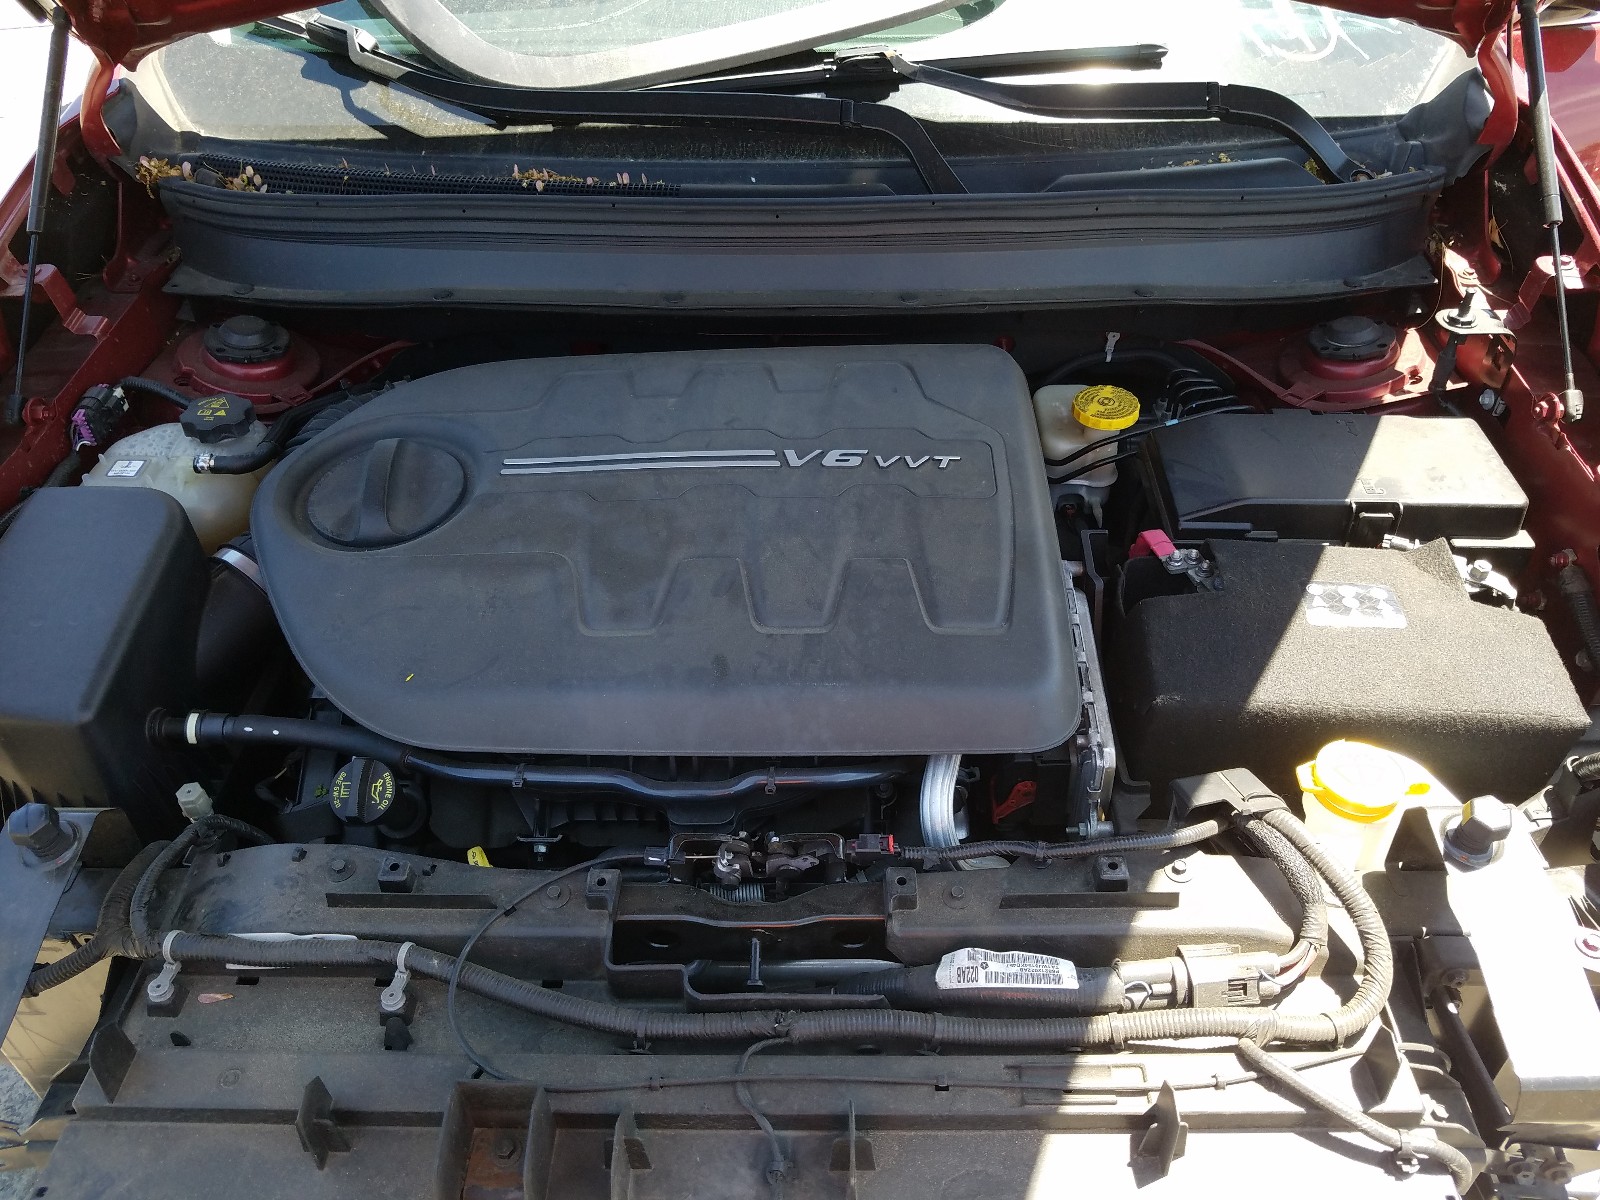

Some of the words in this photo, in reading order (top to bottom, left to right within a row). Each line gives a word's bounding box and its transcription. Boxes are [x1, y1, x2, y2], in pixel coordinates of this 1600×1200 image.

[783, 449, 869, 467] V6
[874, 455, 962, 468] VVT
[335, 771, 347, 785] SAE
[383, 772, 393, 799] ENGINE
[333, 786, 341, 809] 5W-20
[377, 799, 389, 810] OIL
[956, 966, 979, 984] 022AB
